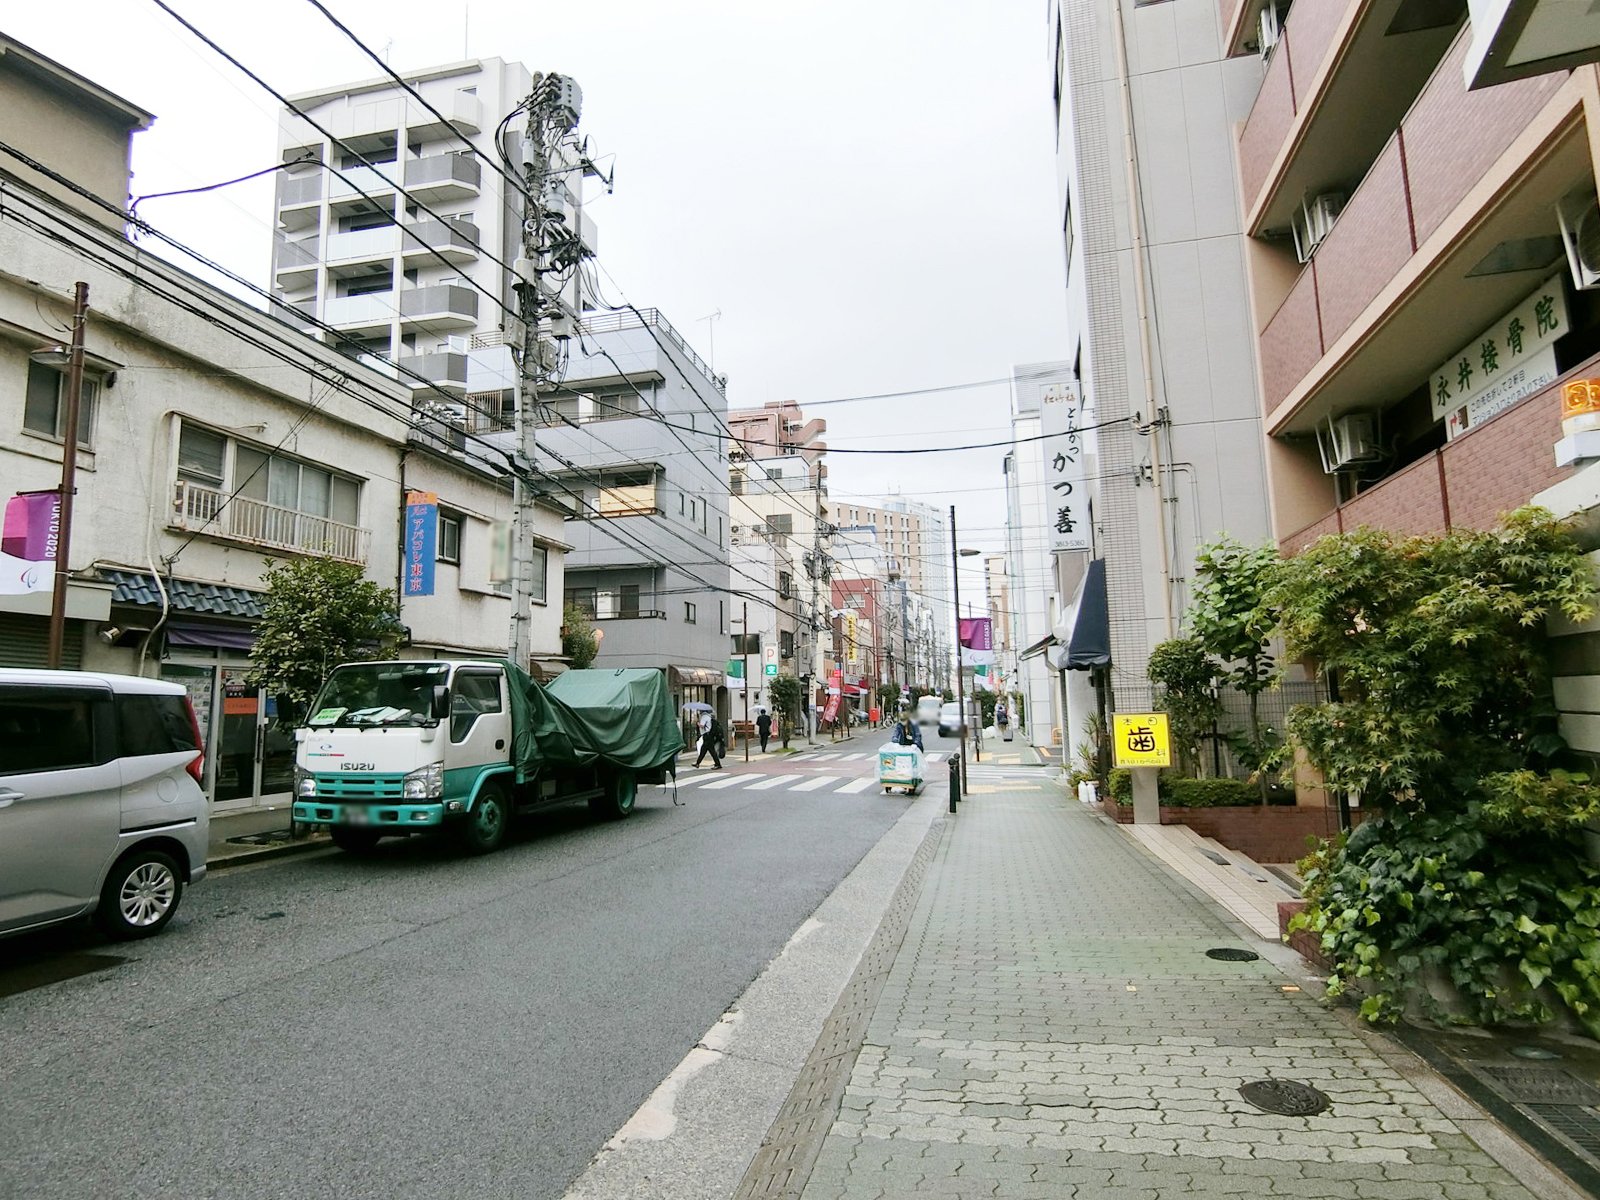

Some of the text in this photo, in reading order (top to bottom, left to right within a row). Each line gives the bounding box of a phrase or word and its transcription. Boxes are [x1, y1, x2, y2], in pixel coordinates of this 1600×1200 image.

[1436, 295, 1559, 407] 永井接骨院
[1067, 407, 1081, 455] とんかつ
[1052, 452, 1077, 534] かつ善
[45, 533, 59, 558] 2020
[410, 518, 424, 591] アパコレ東京
[767, 648, 775, 662] P
